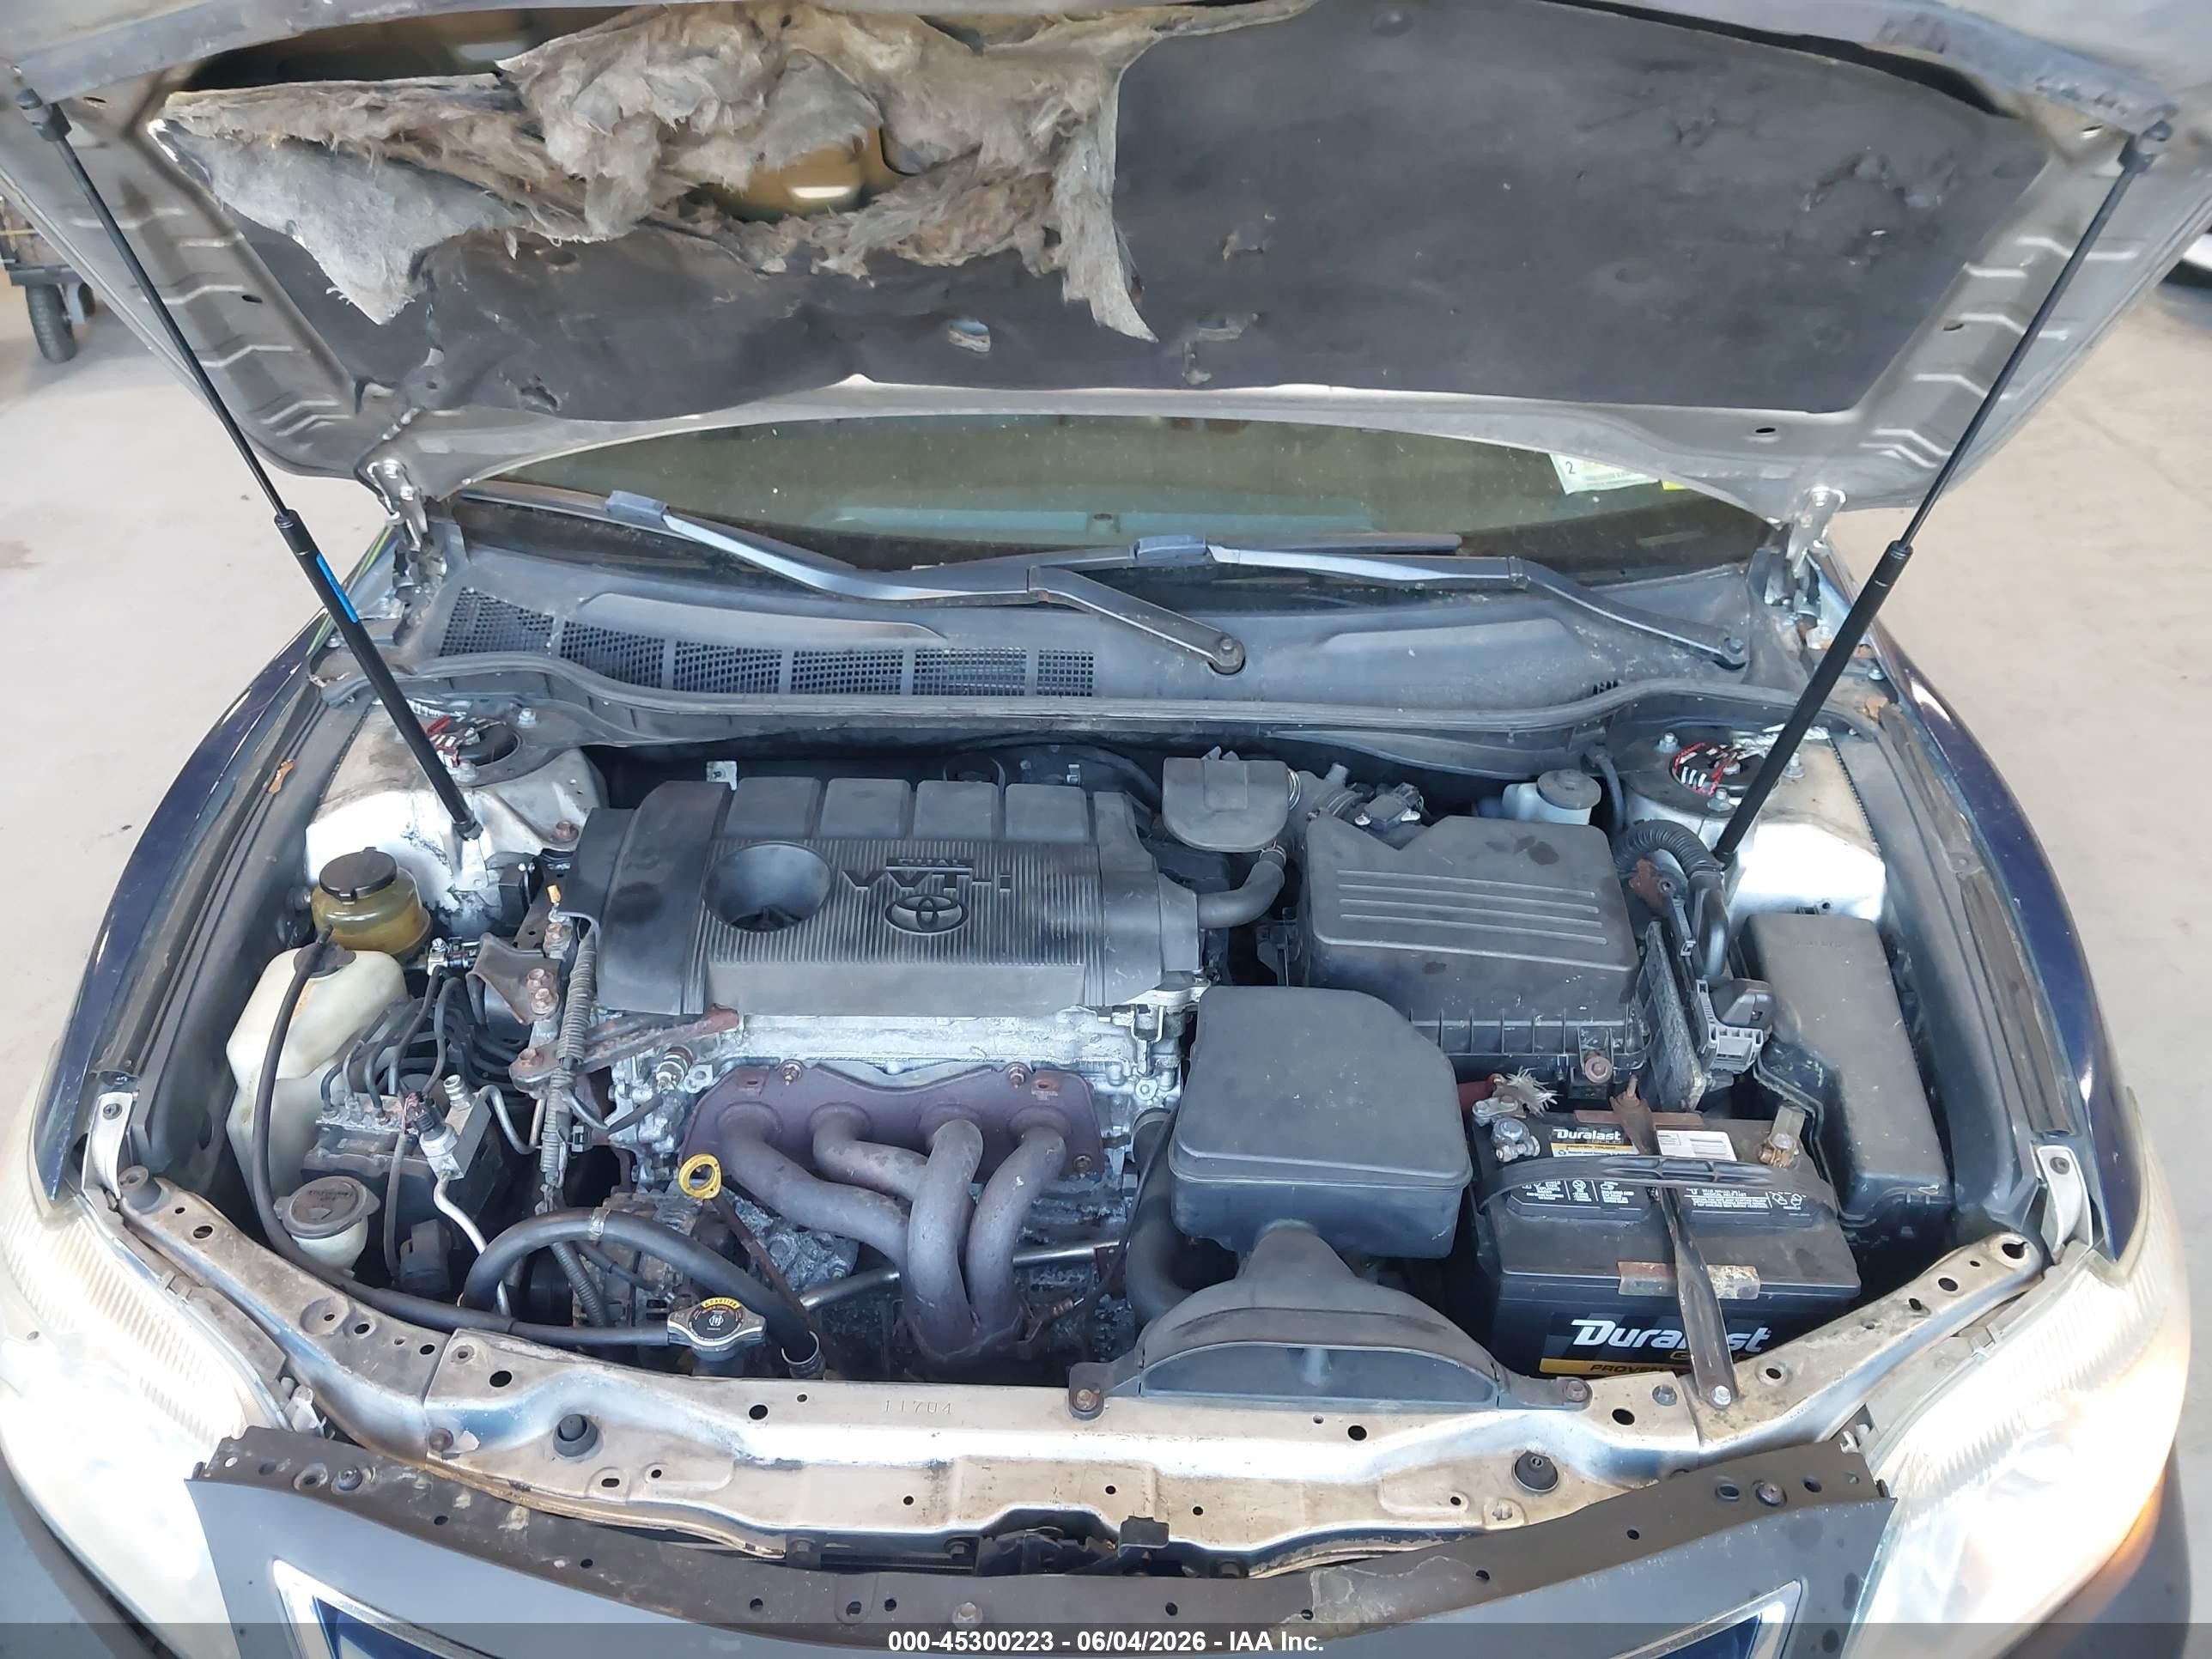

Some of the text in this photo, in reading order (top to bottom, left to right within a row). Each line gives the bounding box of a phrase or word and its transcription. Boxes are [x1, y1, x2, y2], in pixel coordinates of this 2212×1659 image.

[1565, 461, 1577, 474] 2
[1553, 1128, 1621, 1141] Duralast
[1571, 1319, 1769, 1352] Durast
